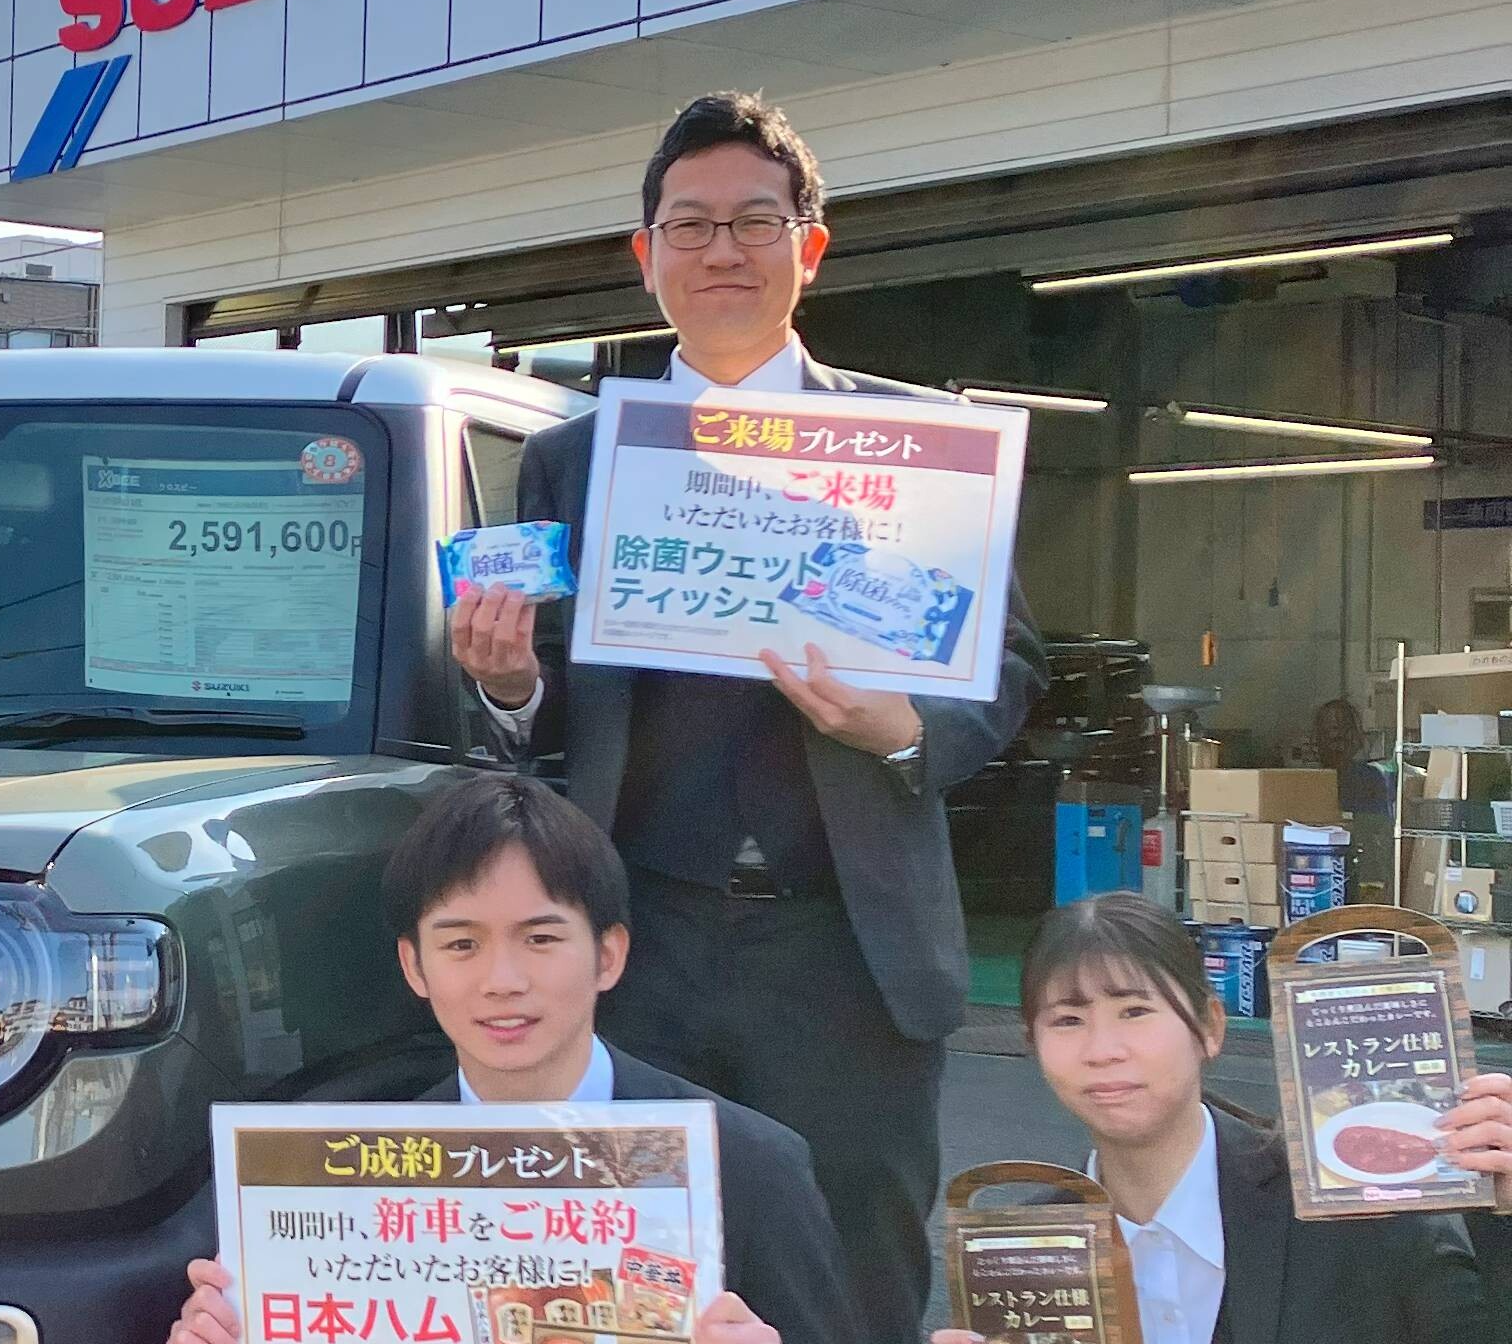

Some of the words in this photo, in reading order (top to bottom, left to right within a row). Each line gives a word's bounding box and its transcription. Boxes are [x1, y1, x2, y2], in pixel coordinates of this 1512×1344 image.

[690, 411, 922, 459] ご来場プレゼント
[684, 467, 898, 510] 期間中、ご来場
[612, 534, 824, 587] 除菌ウェット
[609, 576, 780, 625] ティッシュ
[1304, 1032, 1443, 1058] レストラン仕様
[1341, 1059, 1409, 1078] カレー
[323, 1134, 598, 1180] ご成約プレゼント
[268, 1196, 638, 1245] 期間中、新車をご成約
[261, 1292, 463, 1343] 日本ハム
[971, 1288, 1090, 1308] レストラン仕様
[1004, 1310, 1061, 1329] カレー
